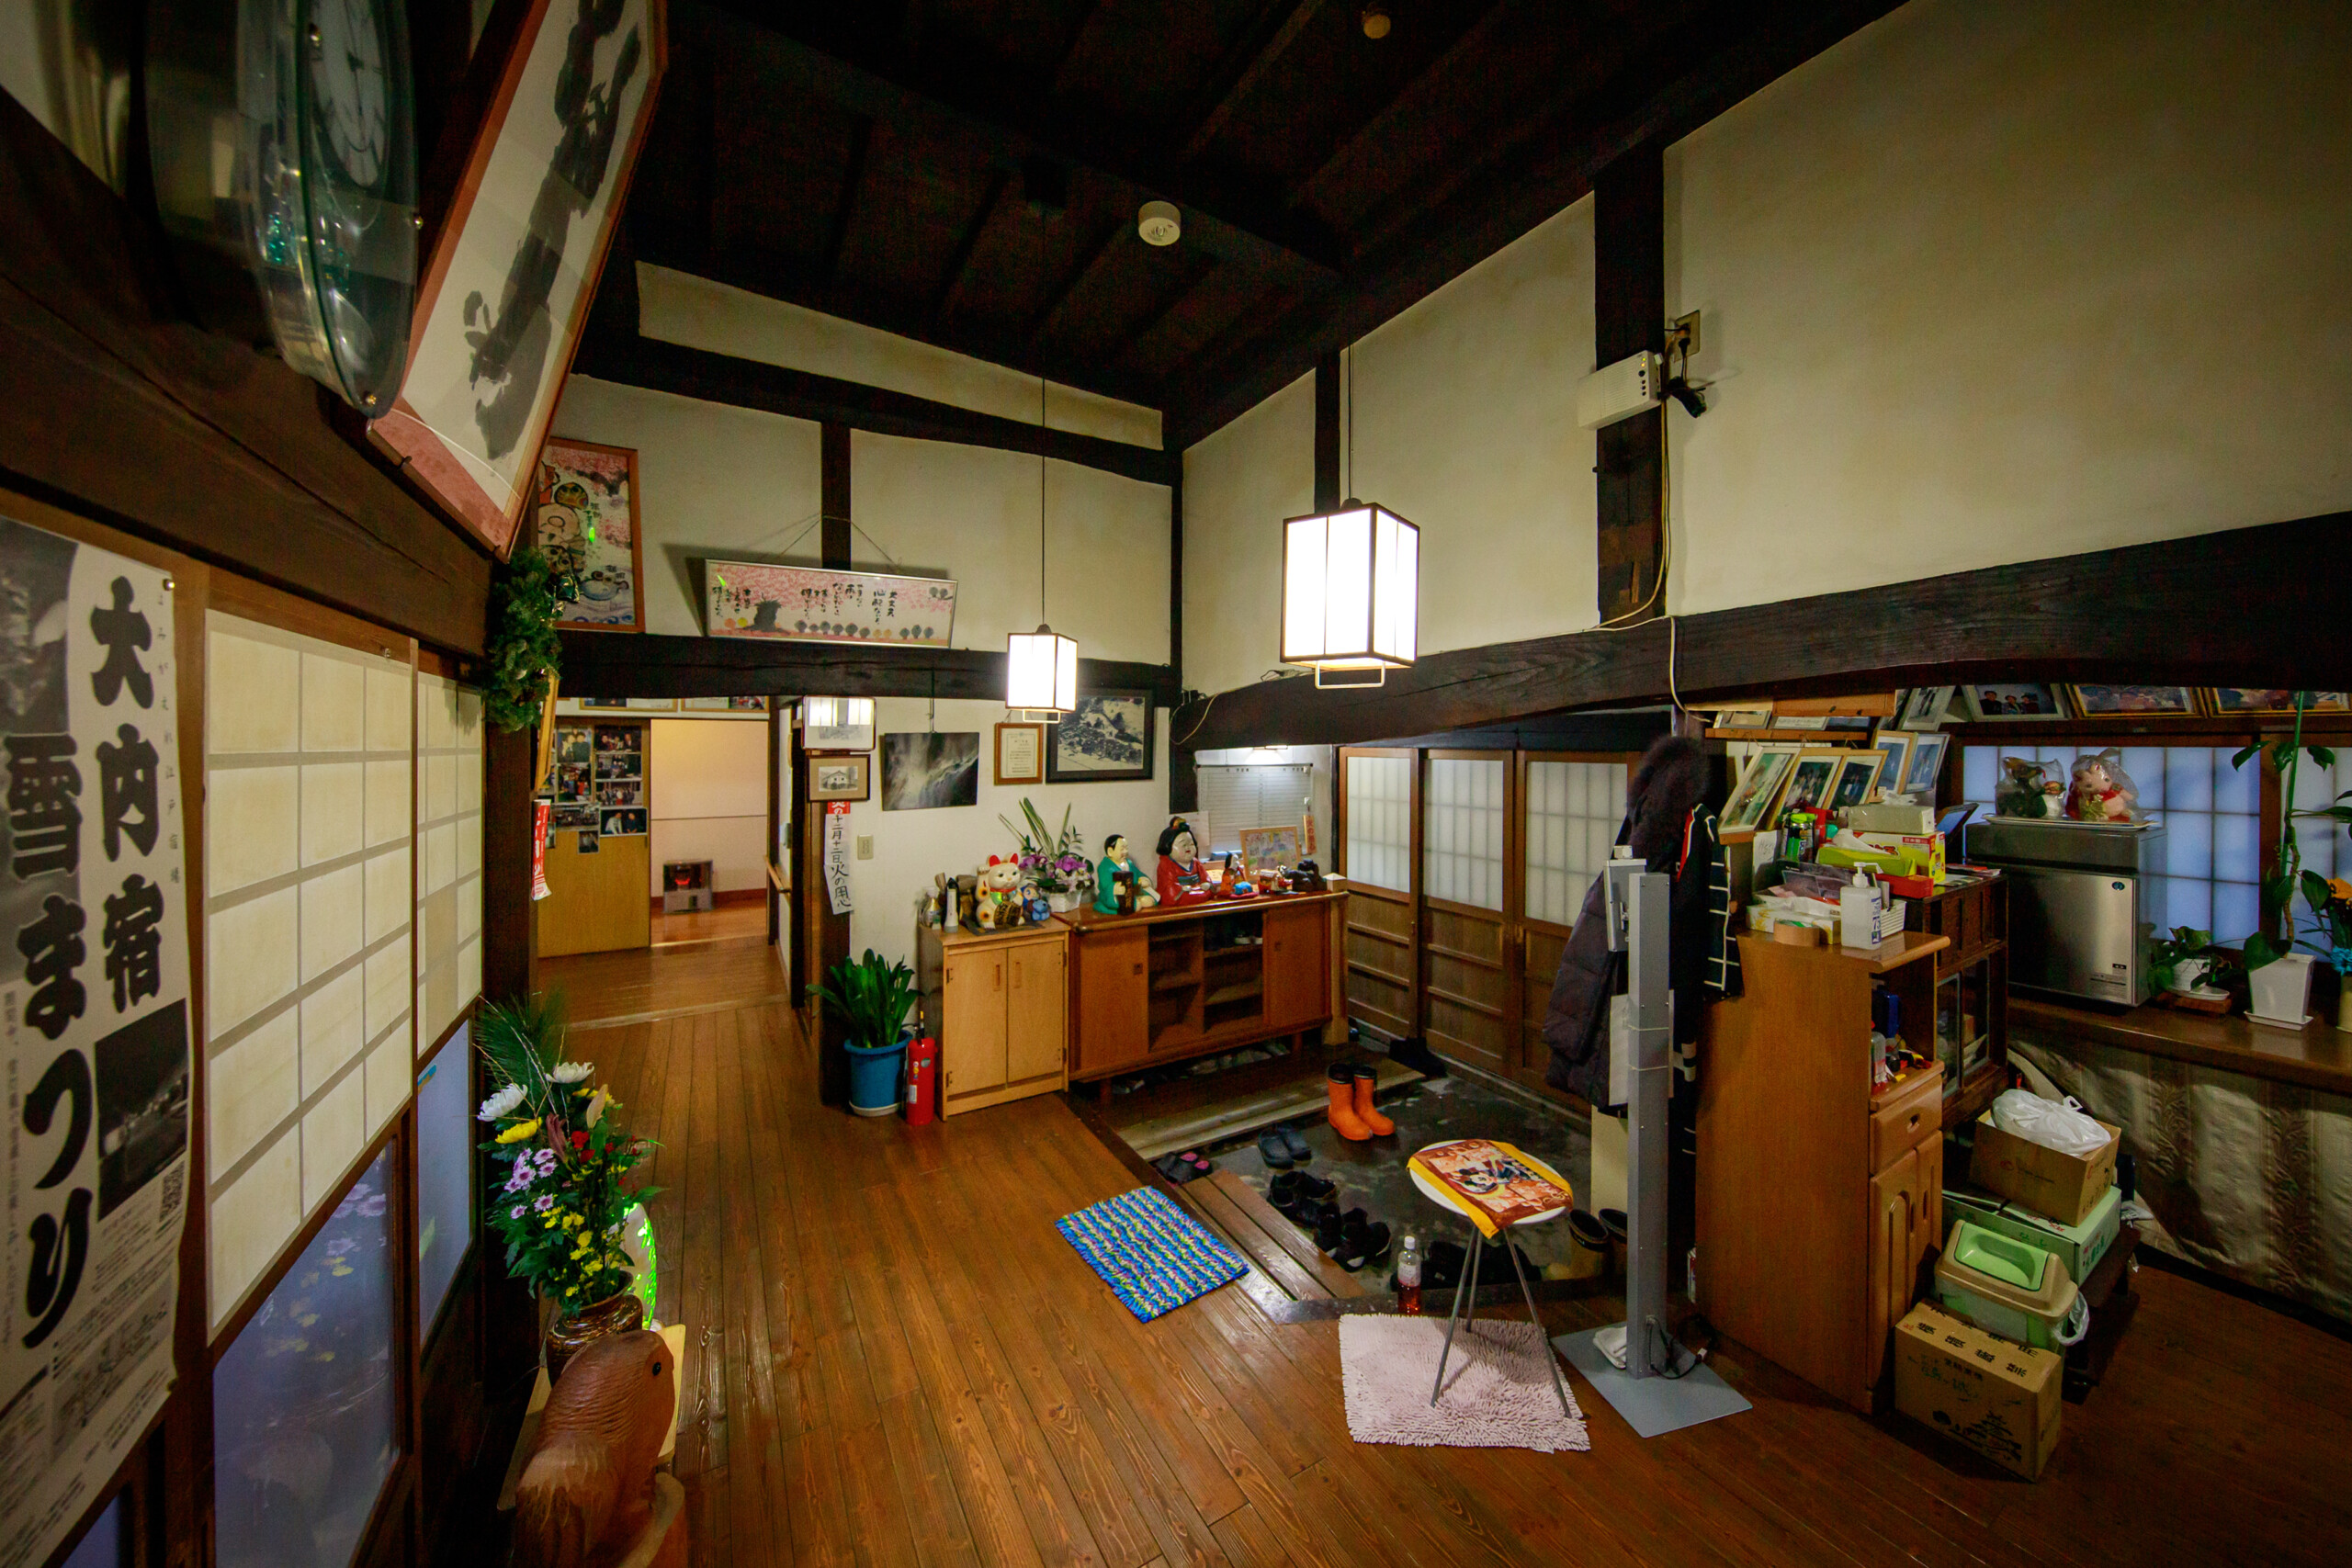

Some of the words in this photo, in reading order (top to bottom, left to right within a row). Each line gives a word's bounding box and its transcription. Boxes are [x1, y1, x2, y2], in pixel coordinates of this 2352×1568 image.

[90, 575, 164, 1013] 大内宿
[830, 815, 852, 908] 十二月十二日火の用心
[7, 734, 93, 1349] 雪まつり
